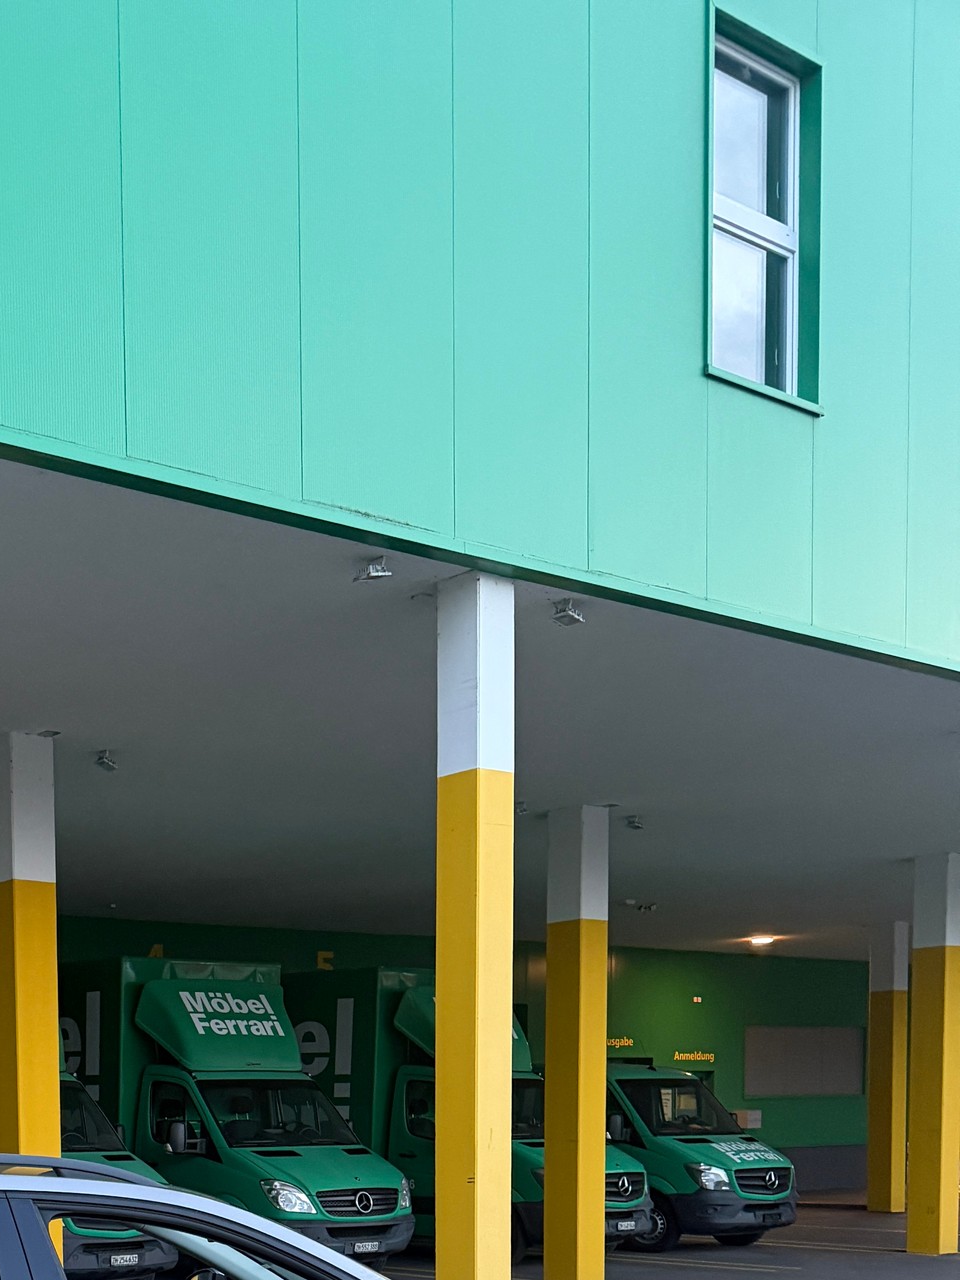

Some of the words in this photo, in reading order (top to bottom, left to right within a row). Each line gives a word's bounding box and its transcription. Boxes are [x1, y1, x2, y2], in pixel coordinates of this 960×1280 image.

[179, 991, 275, 1015] Möbel
[190, 1013, 285, 1037] Ferrari
[674, 1051, 715, 1063] Anmeldung
